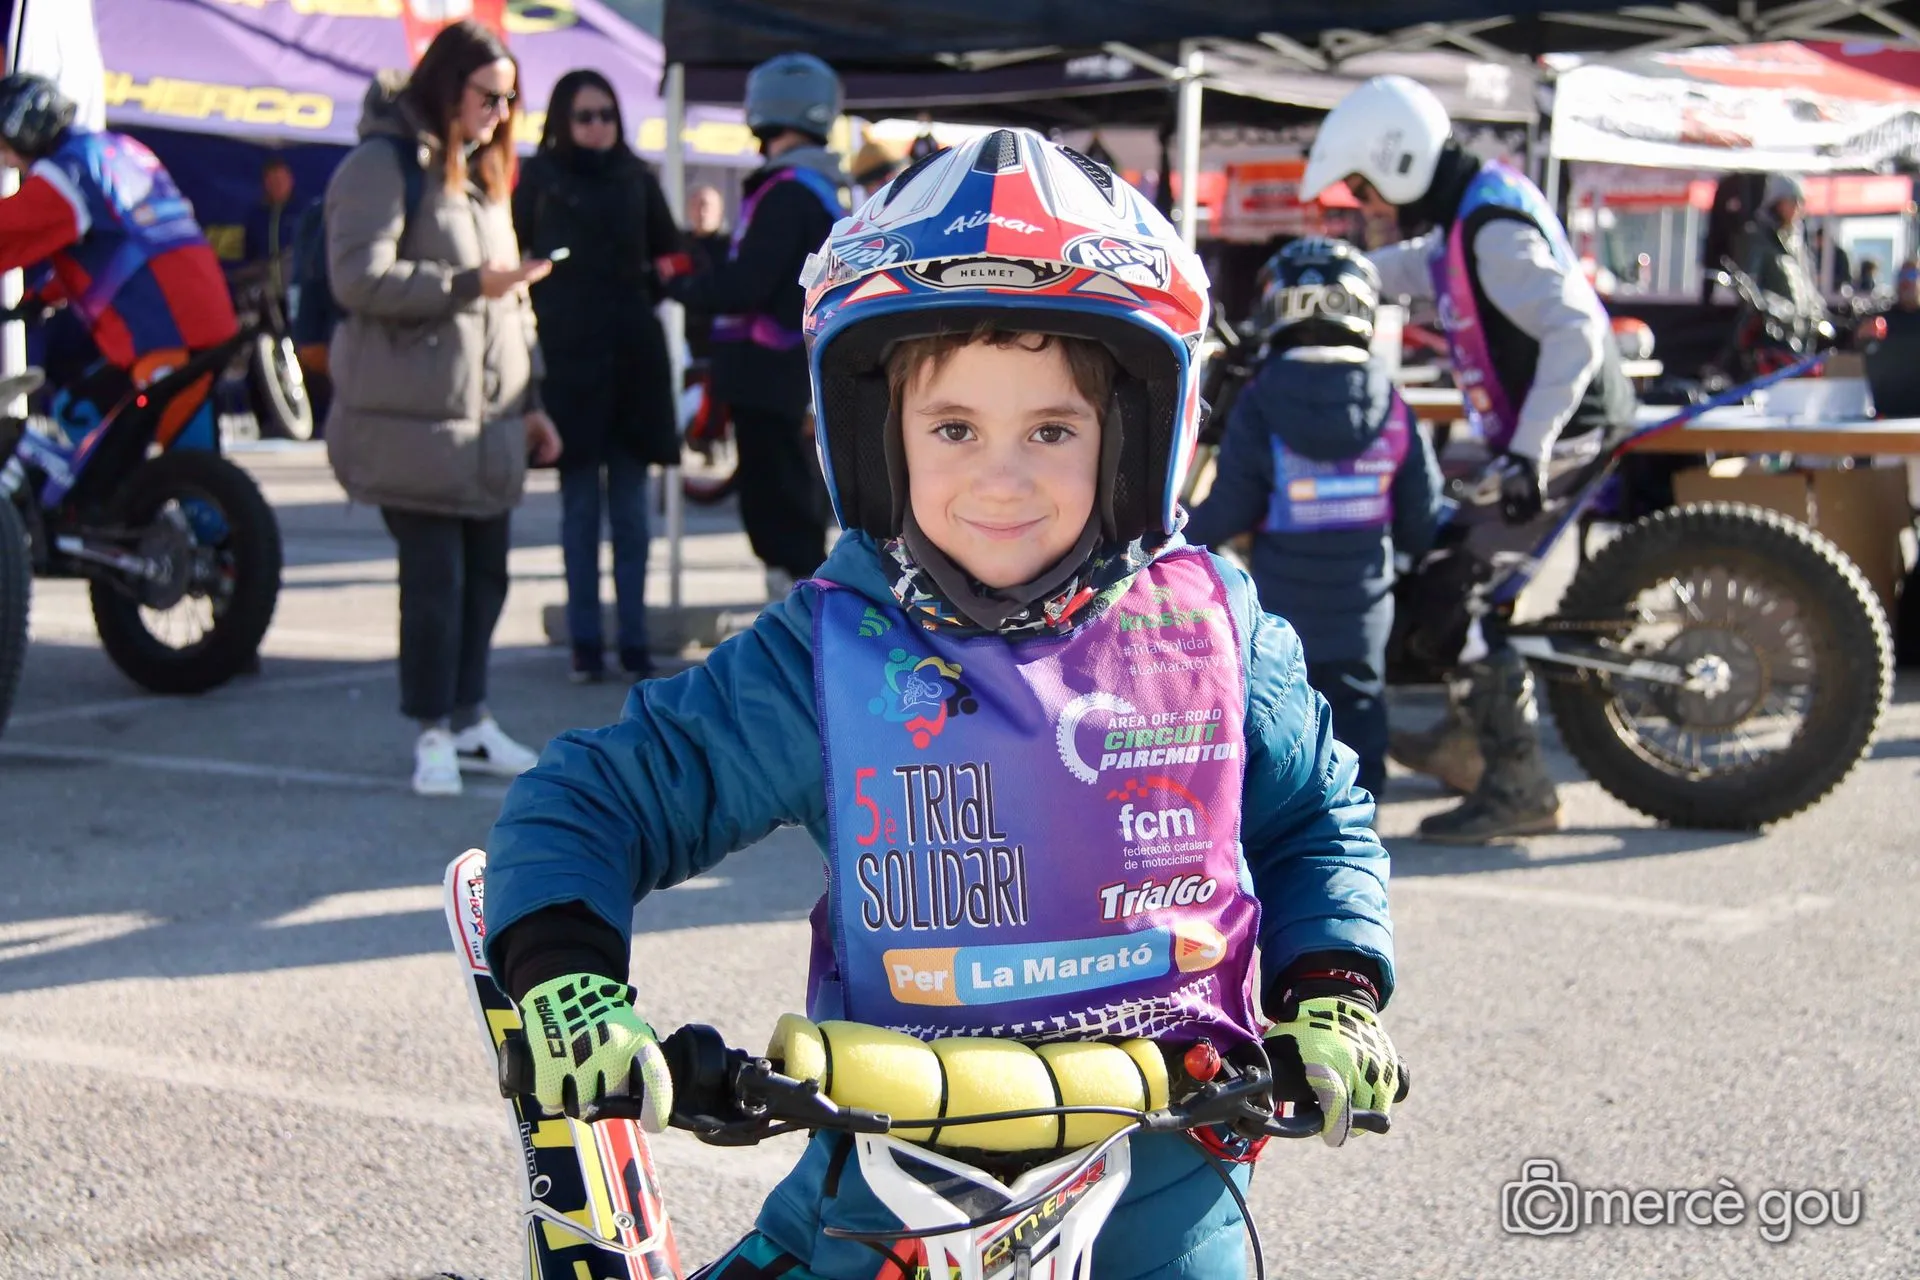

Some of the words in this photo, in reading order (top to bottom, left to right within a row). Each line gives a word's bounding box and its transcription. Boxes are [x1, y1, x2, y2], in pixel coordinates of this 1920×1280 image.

[944, 210, 1044, 236] Aimar
[960, 268, 1015, 278] HELMET
[1107, 715, 1147, 730] AREA
[1151, 708, 1222, 725] OFF-ROAD
[1103, 722, 1221, 751] CIRCUIT
[1118, 803, 1196, 842] fcm
[1123, 843, 1171, 858] federació
[1173, 839, 1213, 852] catalana
[1124, 859, 1138, 870] de
[1141, 853, 1204, 869] motociclisme
[1100, 874, 1217, 920] TrialGo
[892, 963, 950, 993] Per
[971, 961, 1014, 990] La
[1022, 942, 1153, 985] Marató
[533, 995, 567, 1058] COMAS
